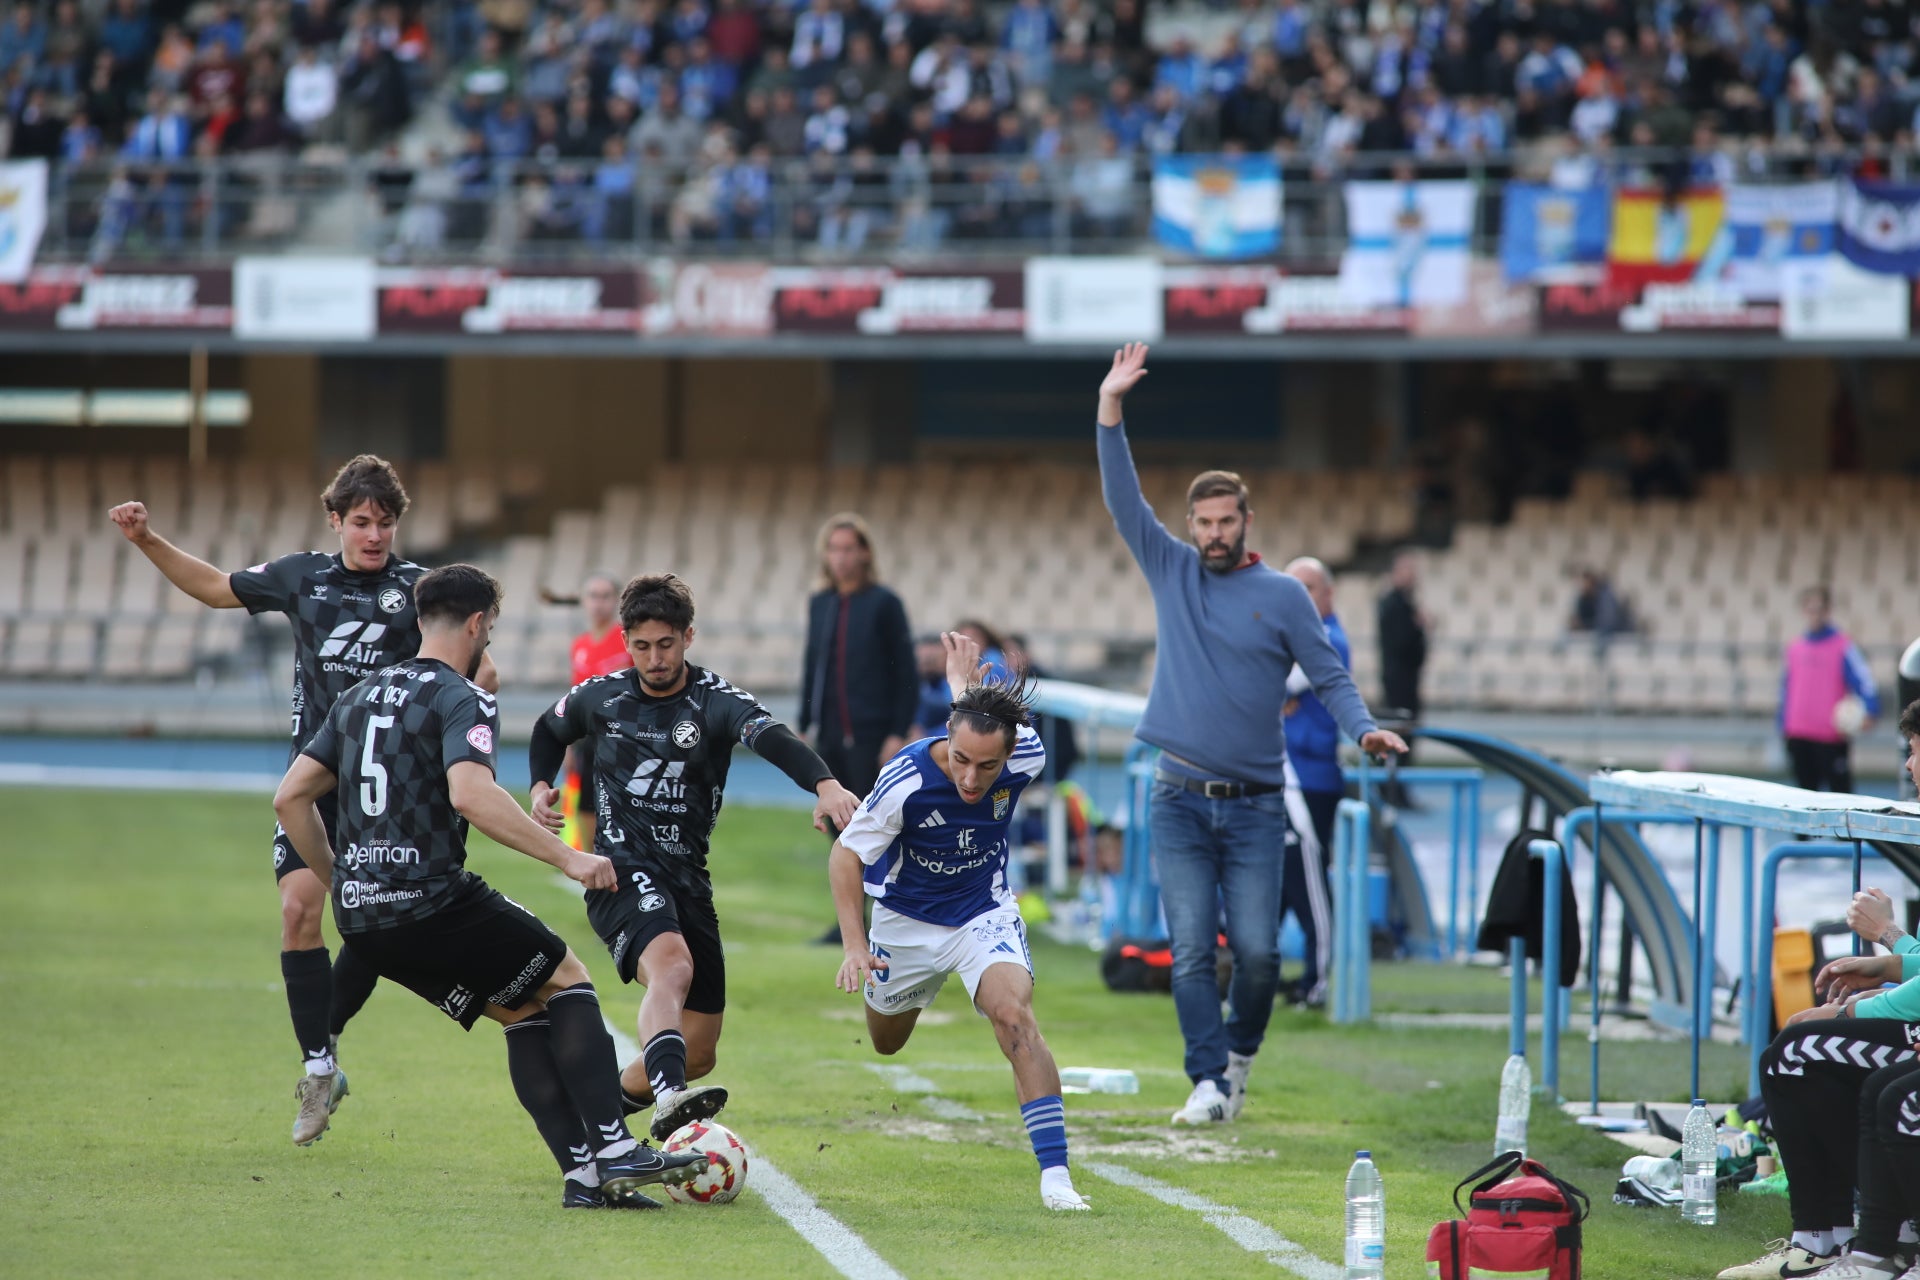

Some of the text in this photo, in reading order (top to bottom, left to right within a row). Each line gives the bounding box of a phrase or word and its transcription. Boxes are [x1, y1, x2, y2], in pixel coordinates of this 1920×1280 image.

[343, 642, 383, 664] Air
[360, 715, 395, 816] 5
[651, 778, 688, 799] Air
[360, 882, 380, 894] High
[631, 871, 656, 895] 2
[360, 889, 423, 905] ProNutrition
